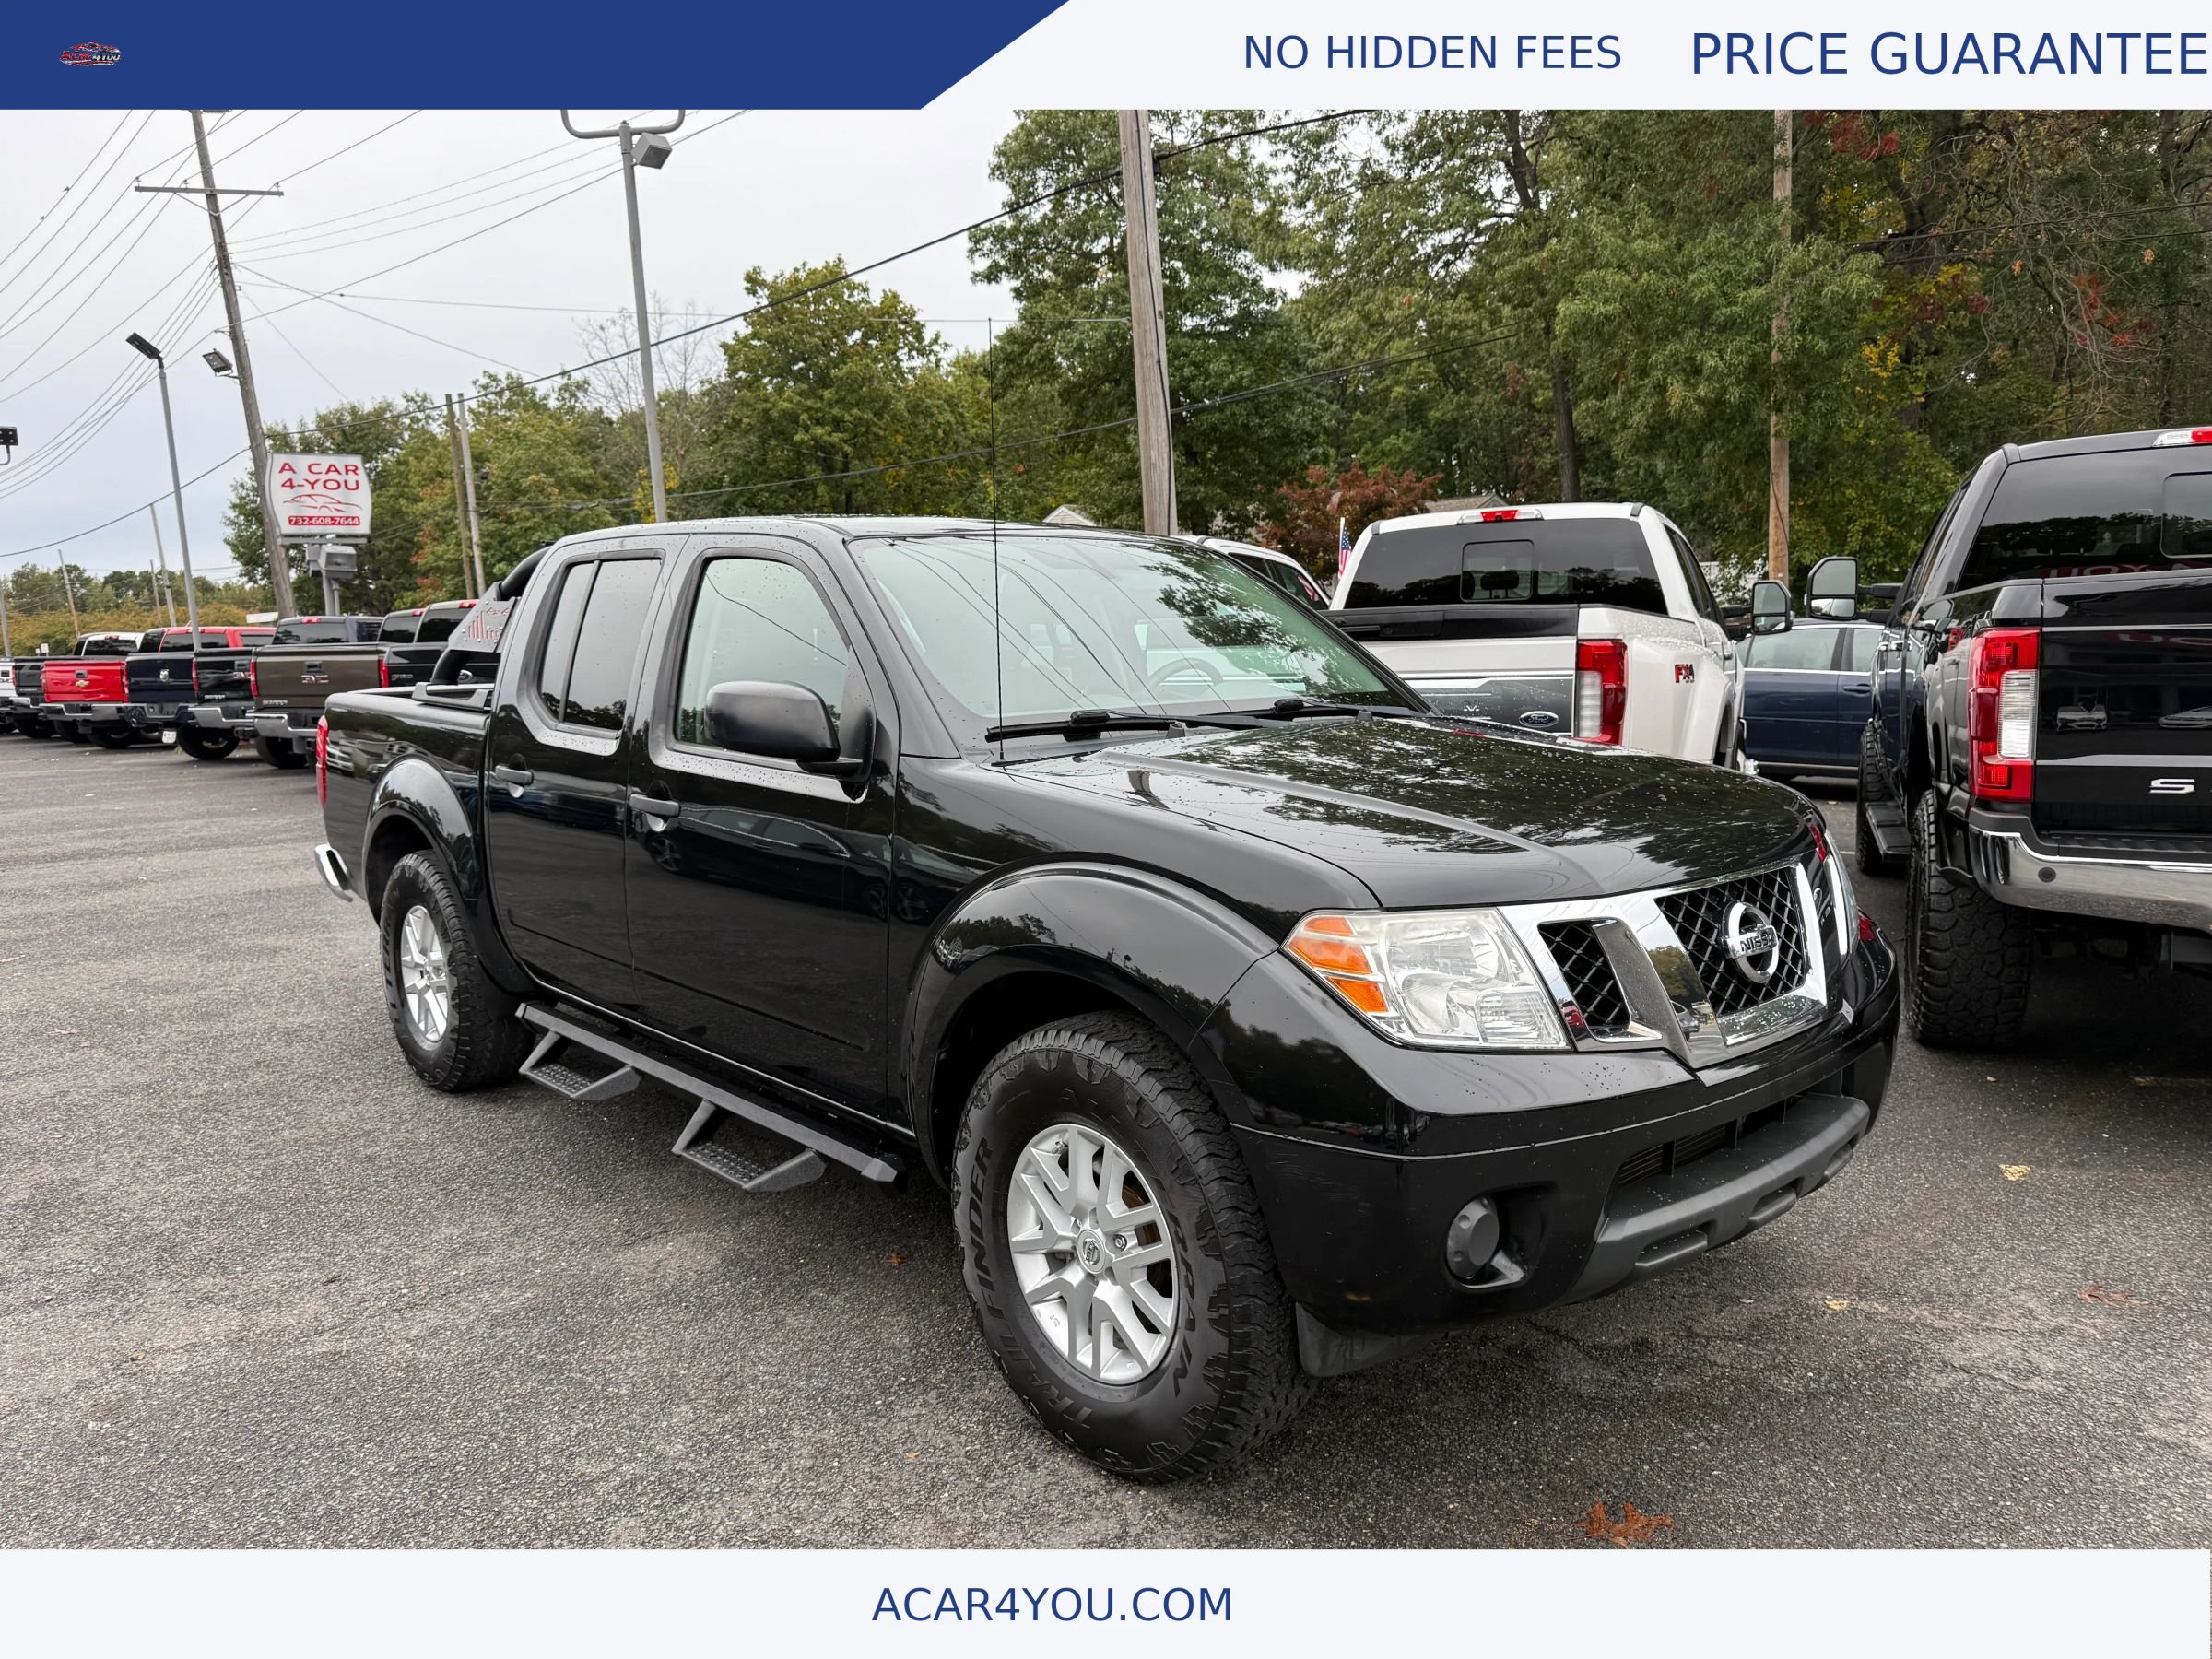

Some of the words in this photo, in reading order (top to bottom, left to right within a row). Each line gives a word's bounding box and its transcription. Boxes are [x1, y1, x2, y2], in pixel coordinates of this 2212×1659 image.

[278, 462, 297, 474] A
[307, 463, 359, 476] CAR
[280, 477, 359, 490] 4-YOU
[288, 516, 360, 525] 732-608-7644
[1674, 664, 1695, 683] FX4
[969, 1136, 1006, 1320] FINDER
